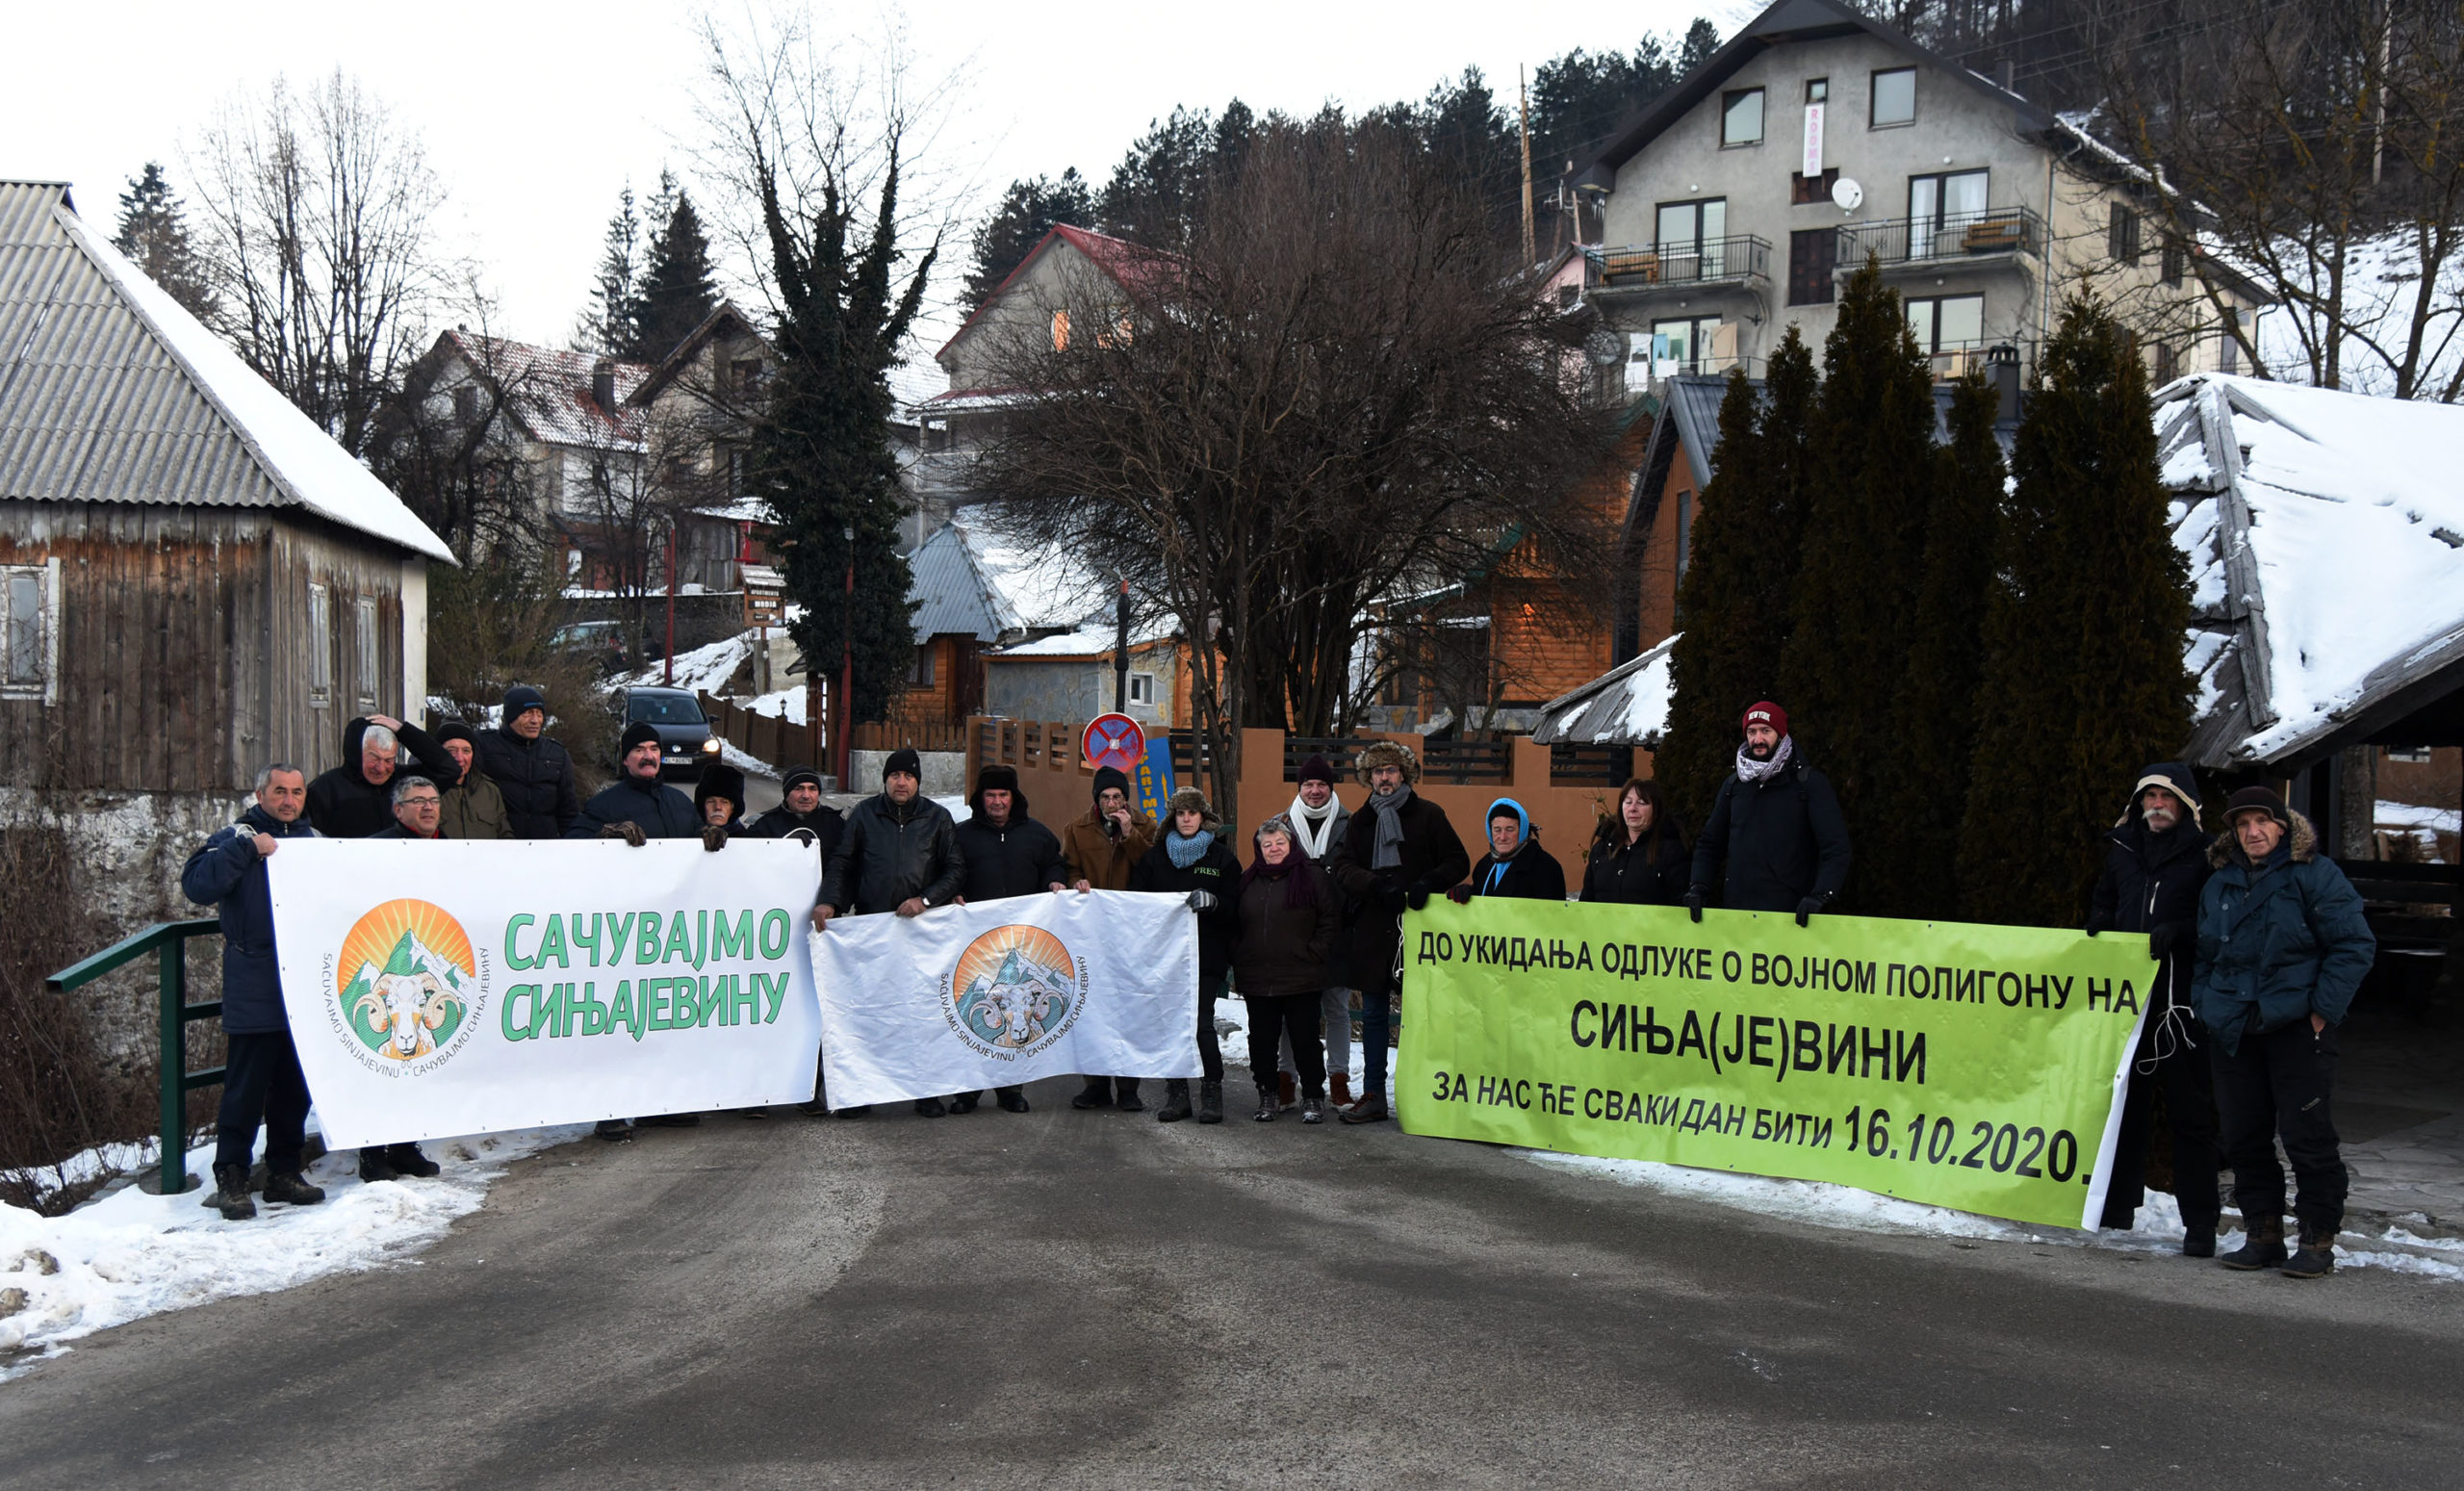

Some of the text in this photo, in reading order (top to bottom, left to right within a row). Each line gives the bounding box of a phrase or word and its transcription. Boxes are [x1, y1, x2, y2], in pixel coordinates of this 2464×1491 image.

[1808, 109, 1819, 171] ROOMS
[504, 909, 790, 971] САЧУВАЈМО
[1419, 931, 2139, 1015] ДО УКИДАЊА ОДЛУКЕ О ВОЈНОМ ПОЛИГОНУ НА
[413, 947, 491, 1076] САЧУВАЈМО СИЊАЈЕВИНУ
[501, 972, 790, 1041] СИЊАЈЕВИНУ
[1027, 956, 1089, 1058] САЧУВАЈМО СИЊАЈЕВИНУ
[1571, 999, 1925, 1085] СИЊА(ЈЕ)ВИНИ
[339, 1033, 399, 1078] SINJAJEVINU
[957, 1031, 1014, 1062] SINJAJEVINU
[1432, 1071, 1469, 1102] ЗА
[1477, 1075, 1530, 1110] НАС
[1538, 1082, 1577, 1116] ЋЕ
[1752, 1107, 1833, 1149] БИТИ
[1846, 1105, 2092, 1185] 16.10.2020.
